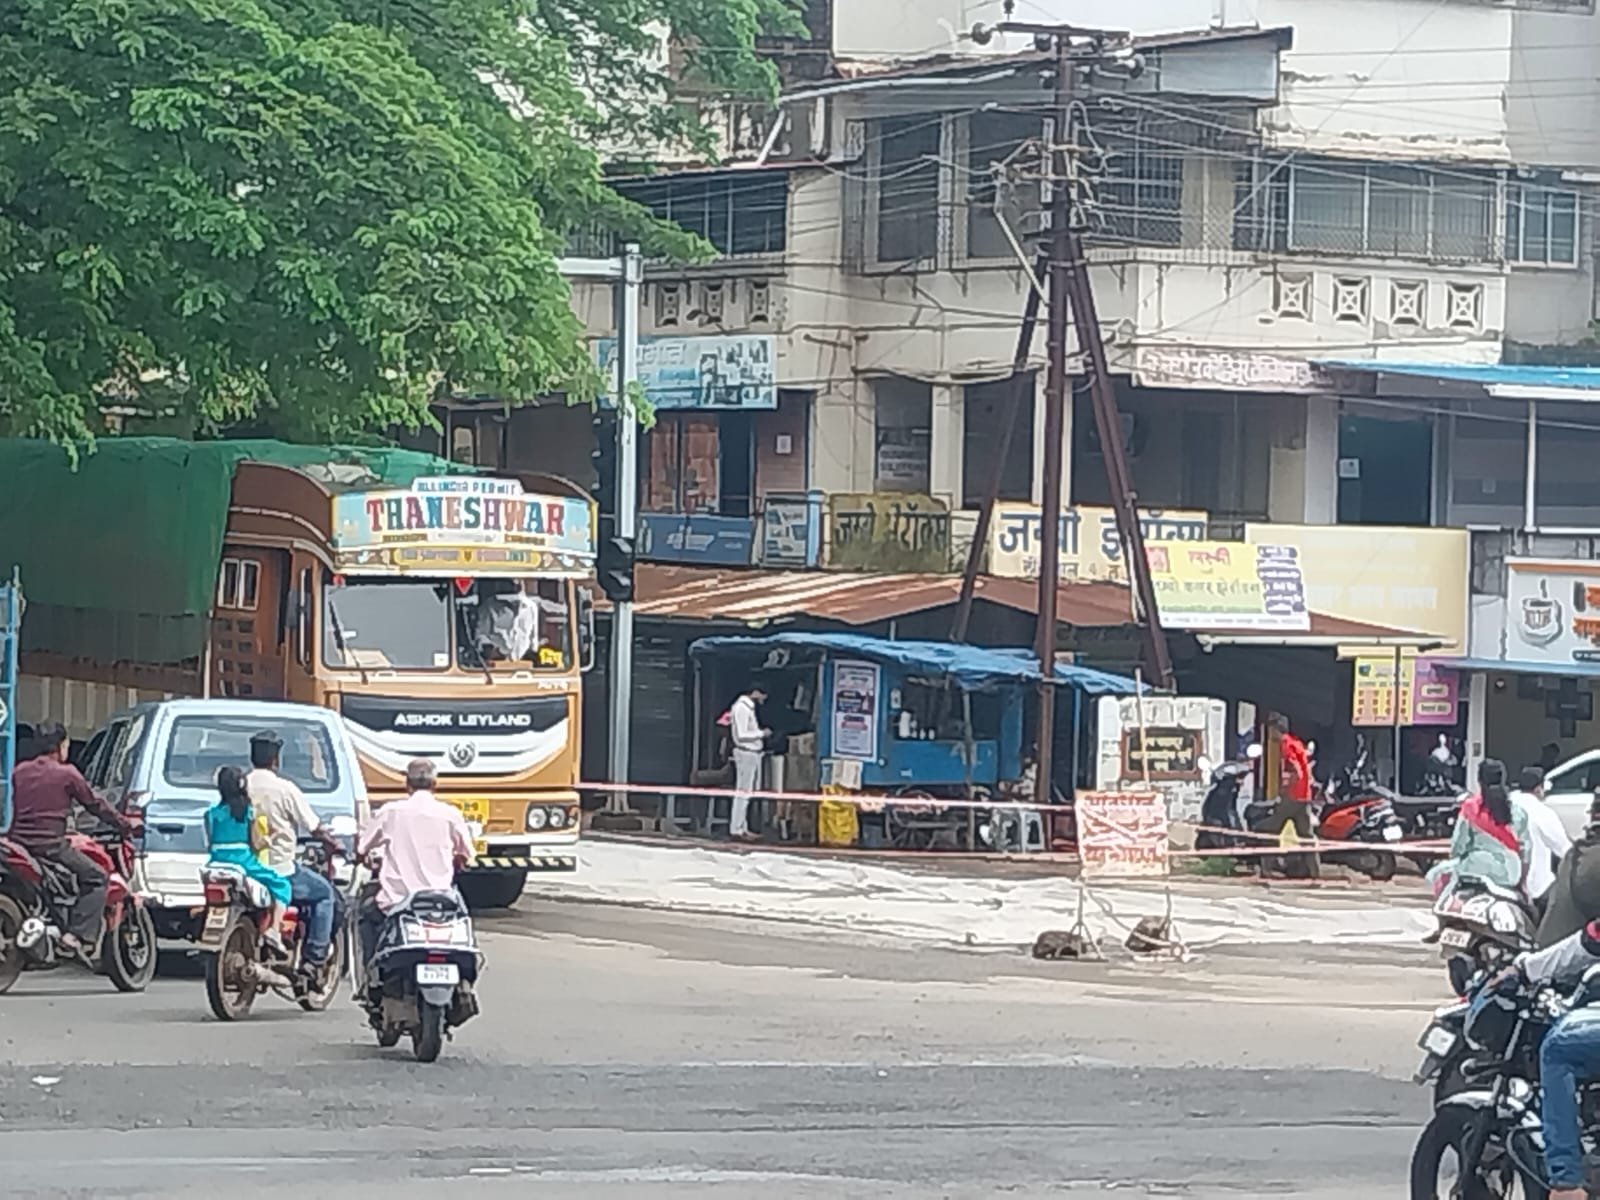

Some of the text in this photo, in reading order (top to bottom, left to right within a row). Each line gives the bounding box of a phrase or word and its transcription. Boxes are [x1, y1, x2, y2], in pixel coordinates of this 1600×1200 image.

[366, 496, 565, 536] THANESHWAR
[394, 712, 531, 727] ASHOK LEYLAND
